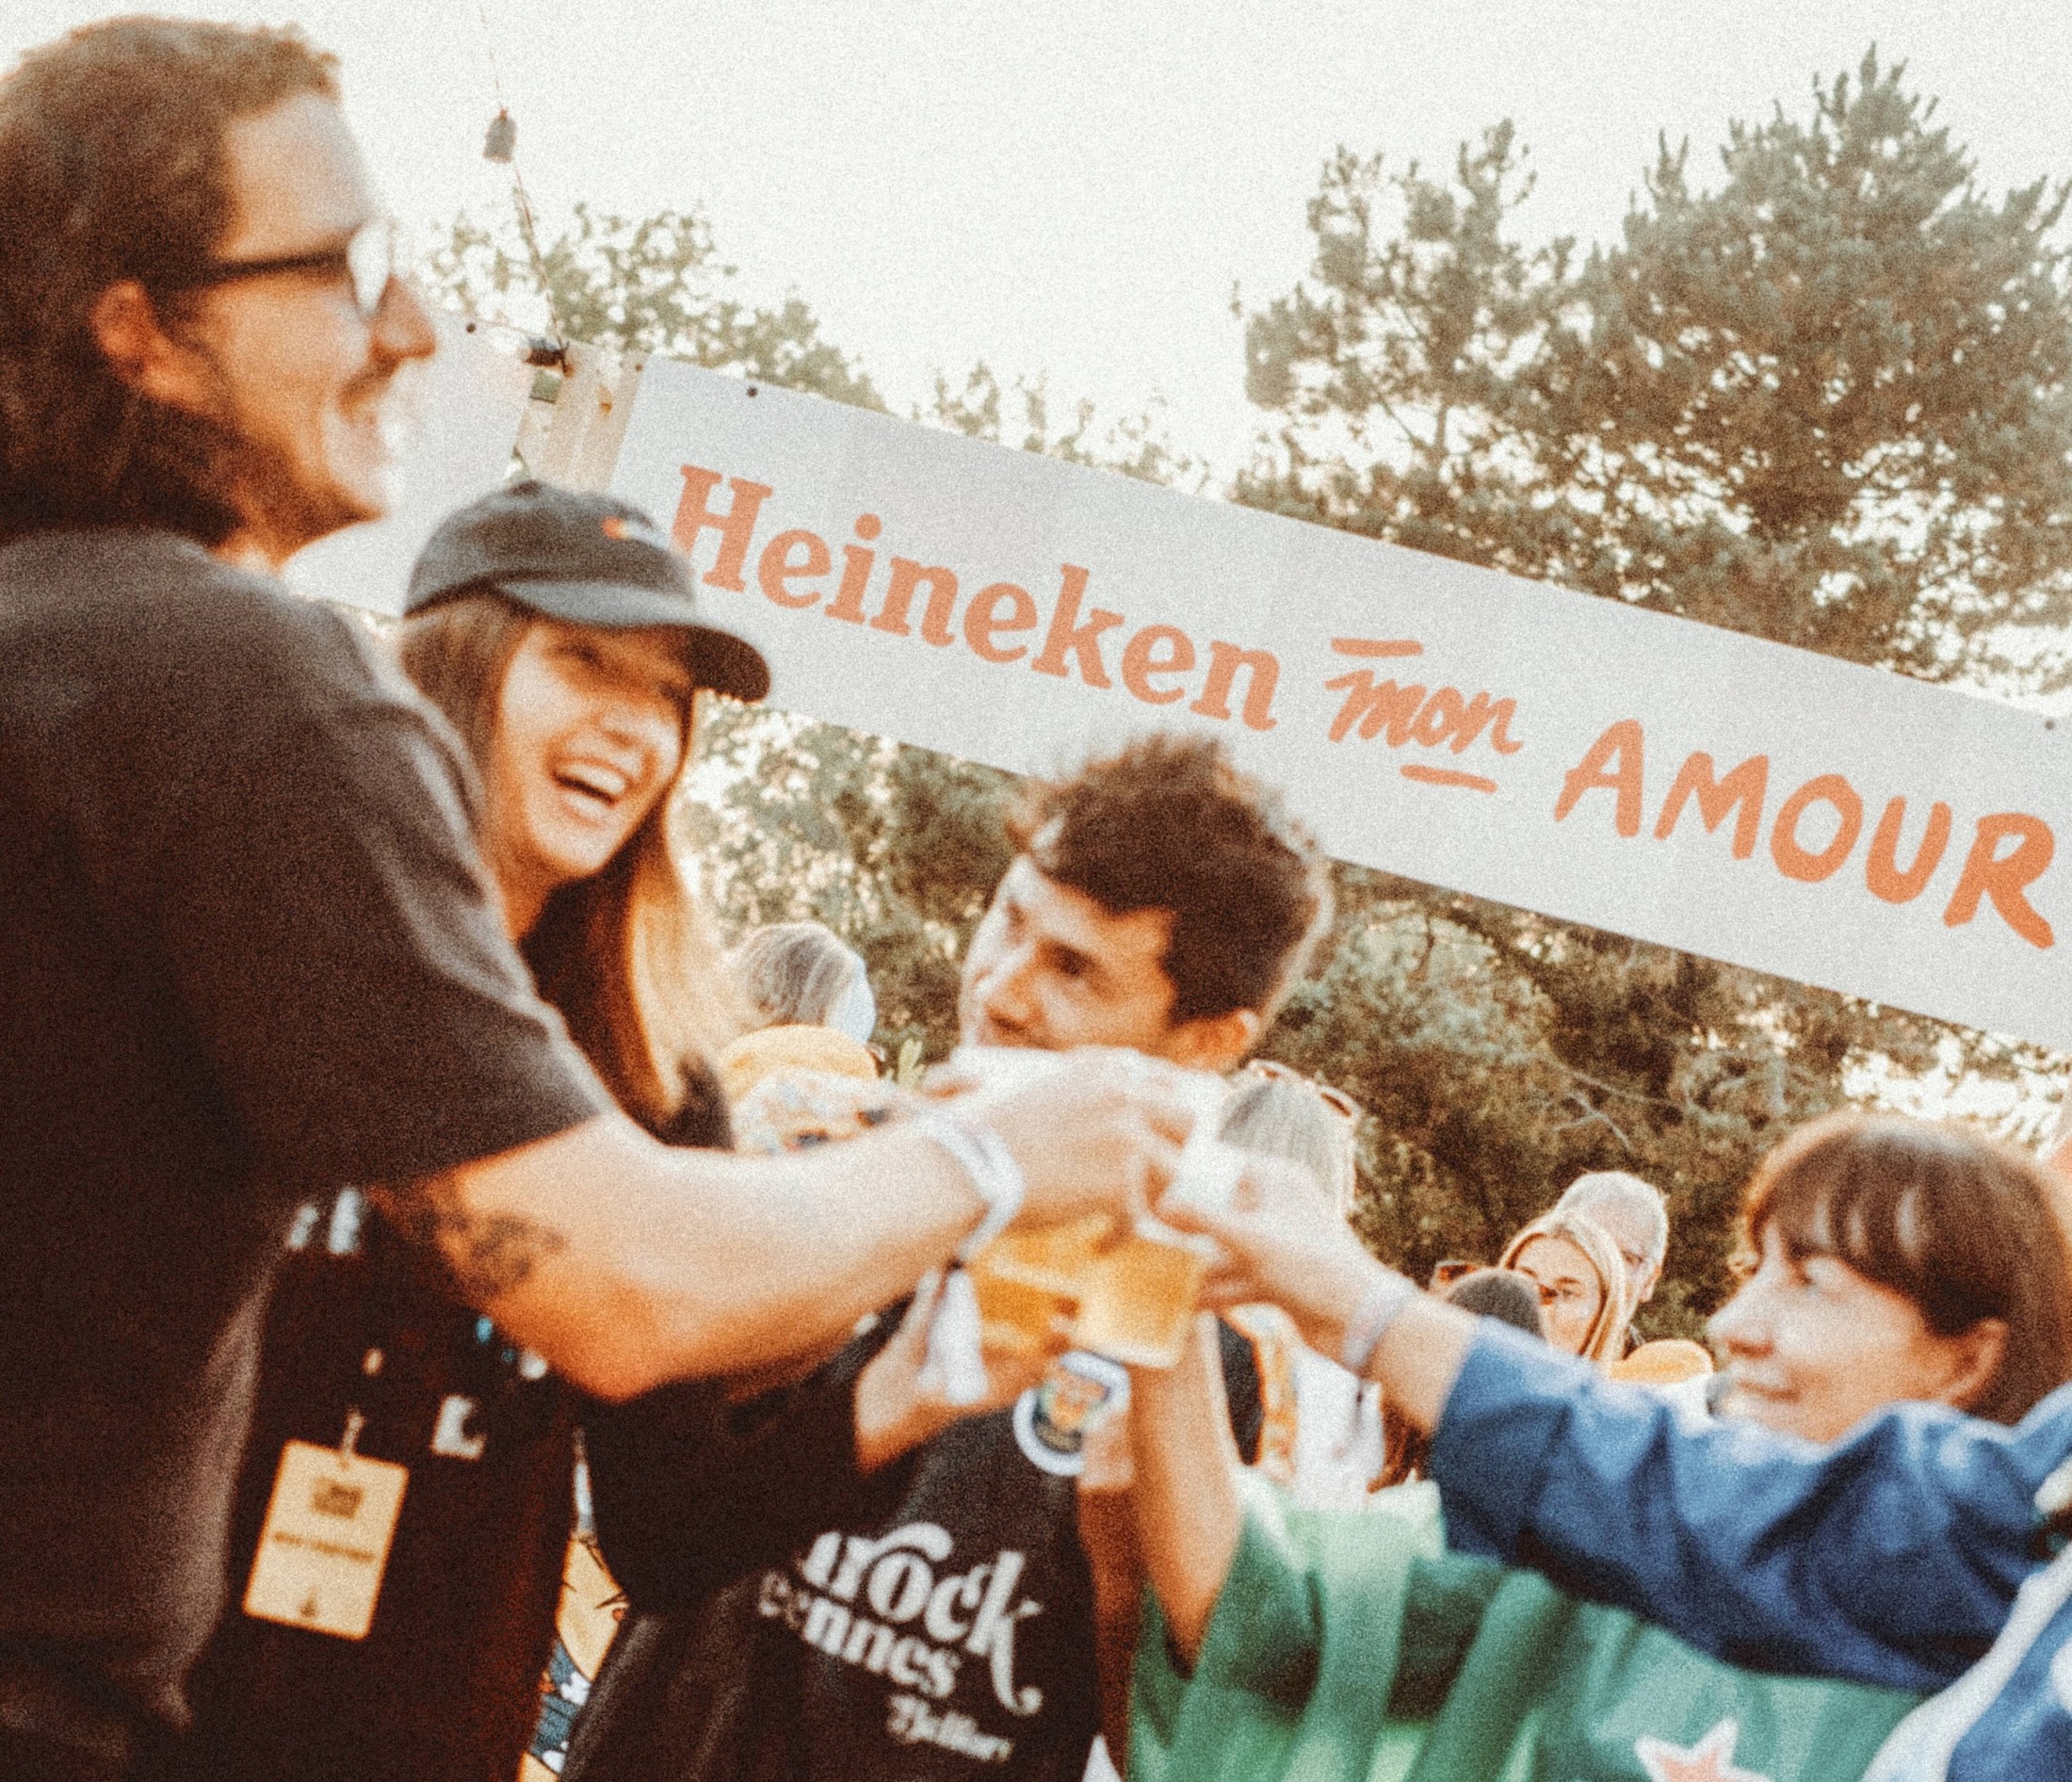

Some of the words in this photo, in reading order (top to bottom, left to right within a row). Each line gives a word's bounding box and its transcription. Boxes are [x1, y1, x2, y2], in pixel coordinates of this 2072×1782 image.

[672, 464, 1280, 732] Heineken
[1325, 668, 1521, 756] mon
[1554, 719, 2057, 950] AMOUR
